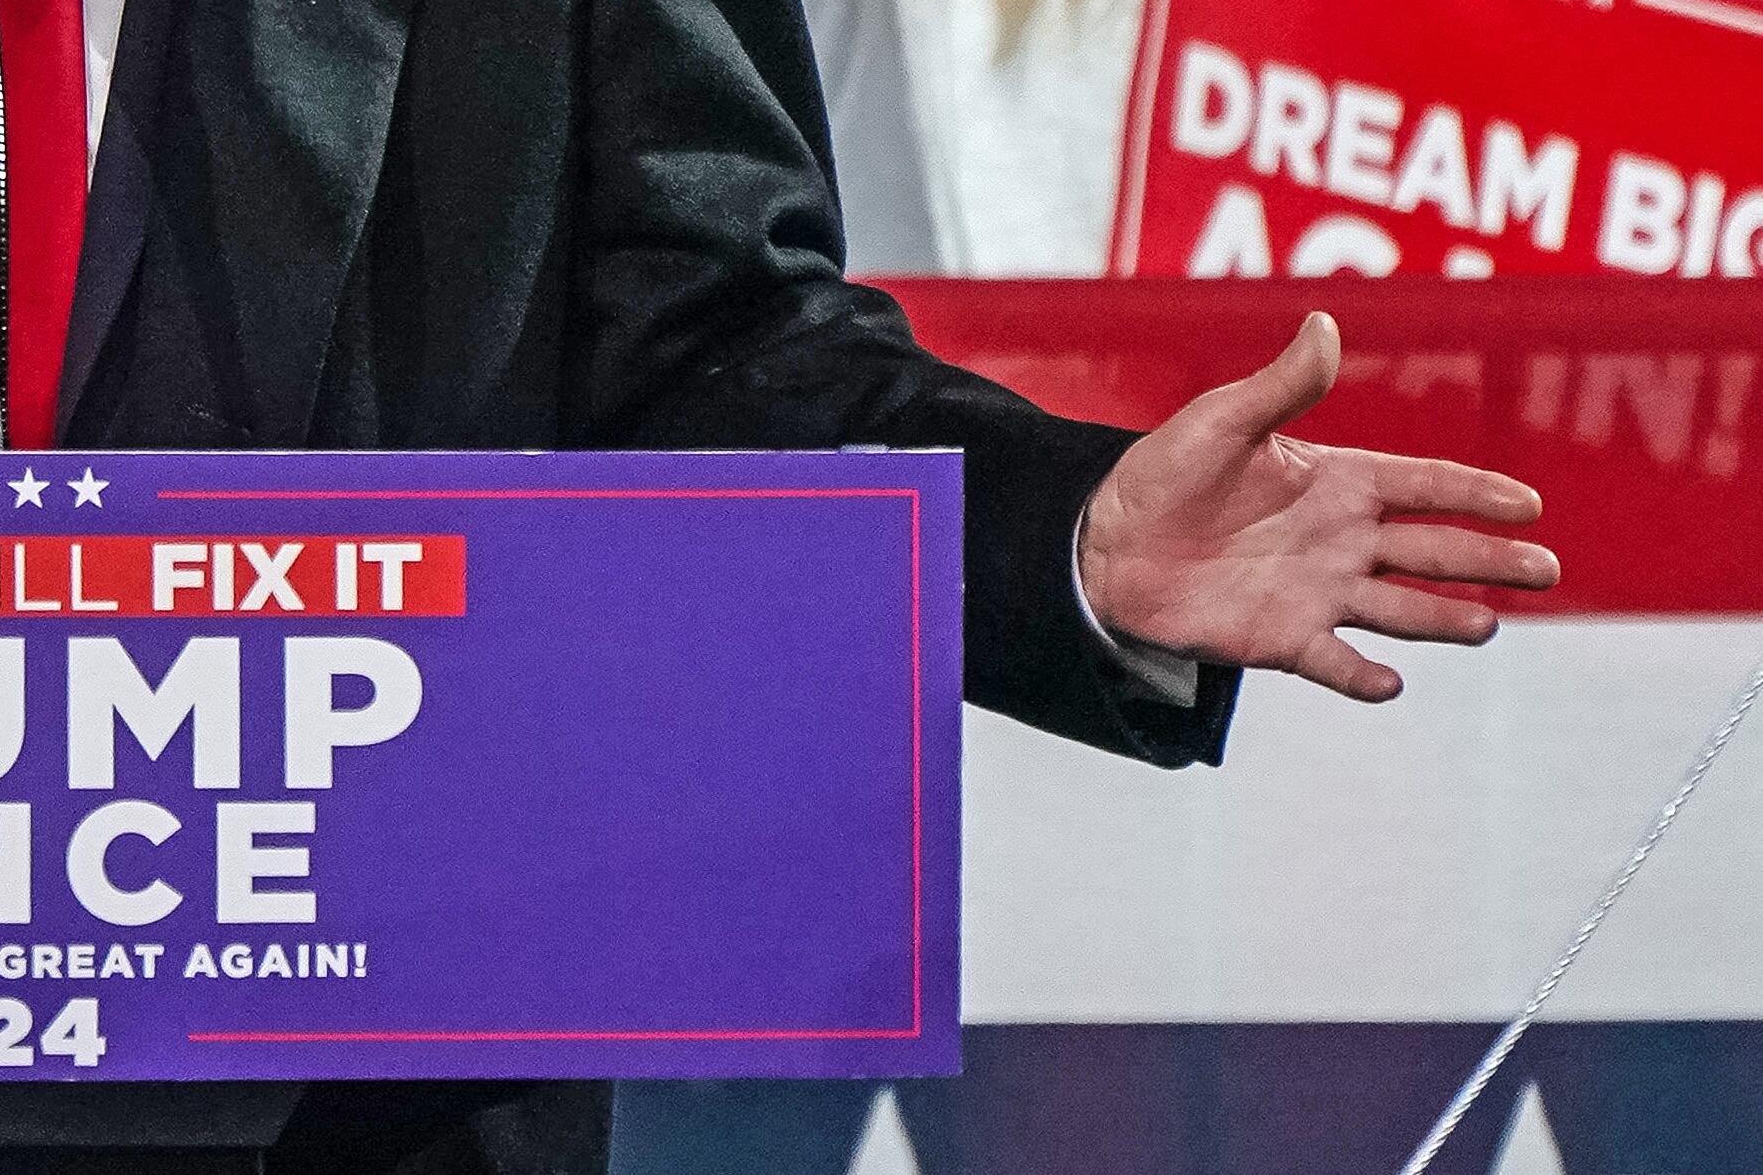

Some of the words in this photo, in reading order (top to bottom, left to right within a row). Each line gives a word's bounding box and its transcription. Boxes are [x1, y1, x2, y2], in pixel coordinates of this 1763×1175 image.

[1171, 39, 1580, 252] DREAM
[152, 542, 305, 611] FIX
[335, 541, 423, 611] IT
[182, 942, 368, 979] AGAIN!
